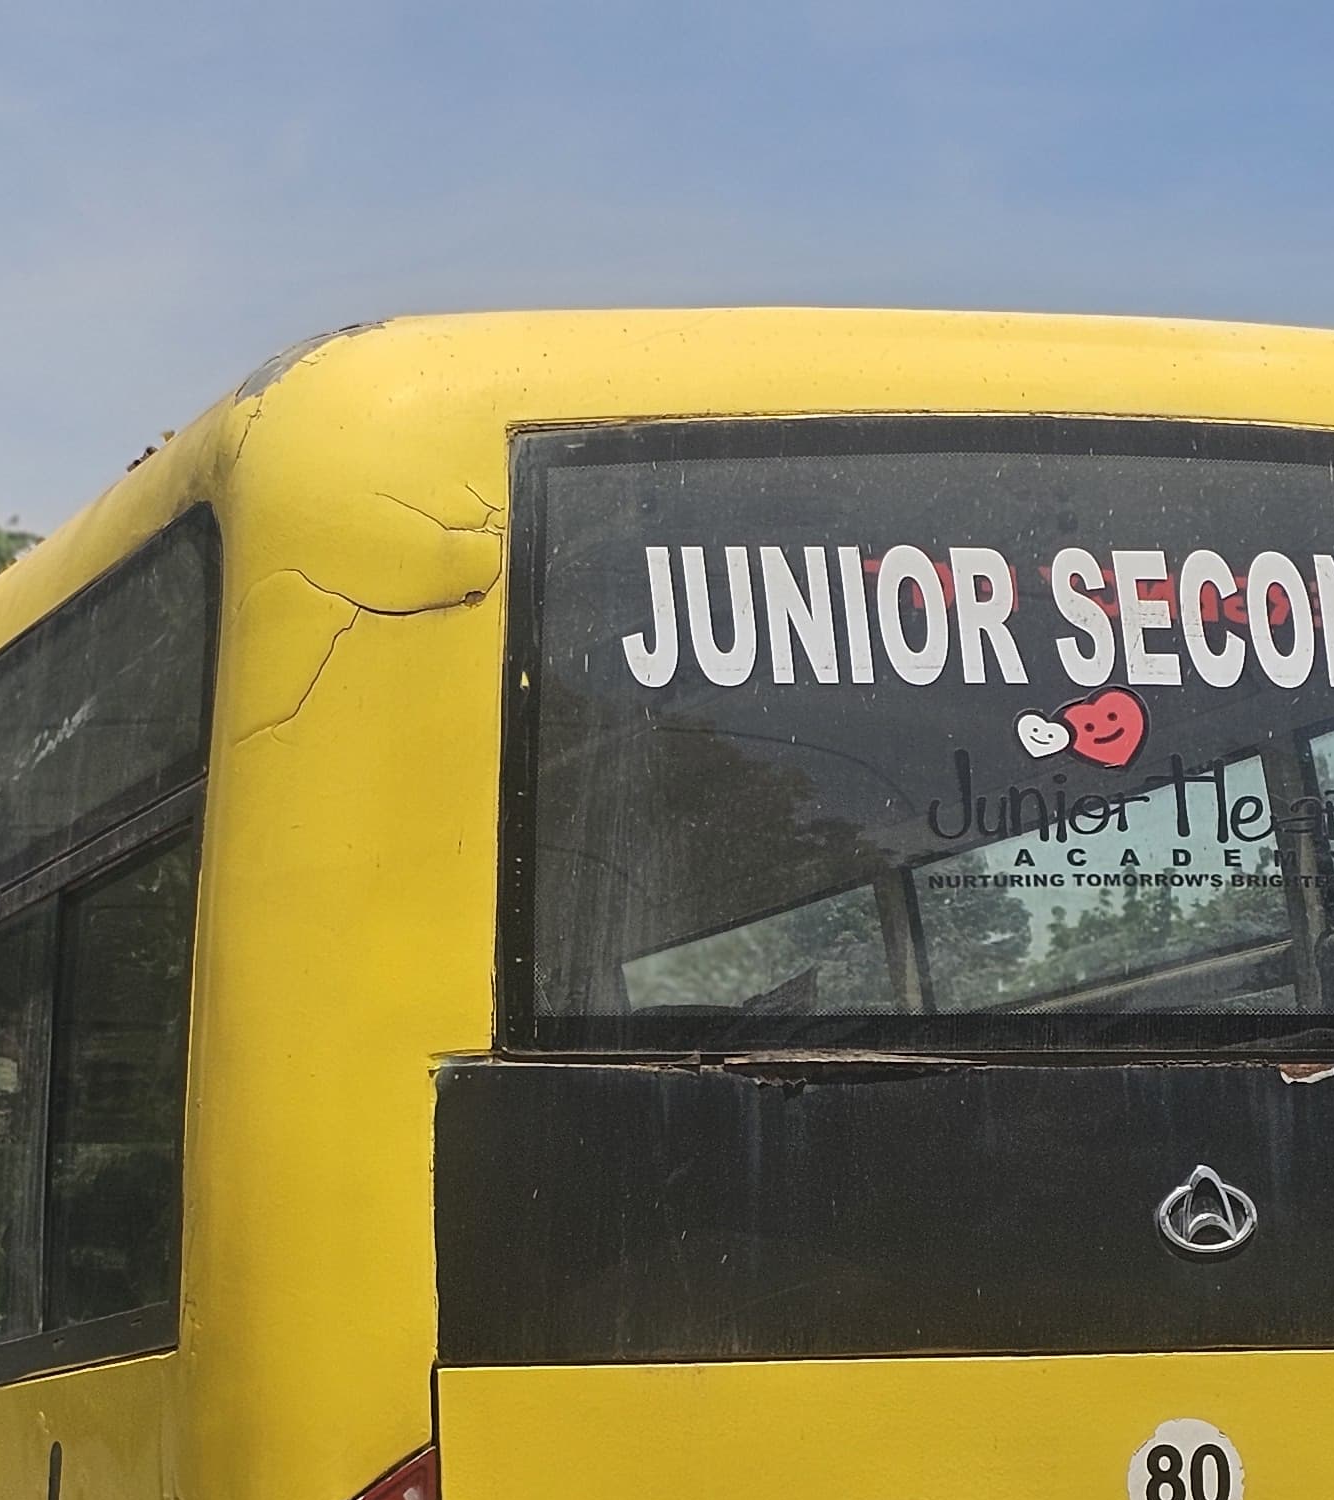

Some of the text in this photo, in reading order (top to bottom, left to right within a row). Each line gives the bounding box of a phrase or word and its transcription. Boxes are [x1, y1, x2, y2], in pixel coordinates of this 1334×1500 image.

[621, 544, 1029, 689] JUNIOR
[927, 748, 1150, 844] Junior
[928, 873, 1065, 889] NURTURING
[1073, 873, 1223, 889] TOMORROW'S
